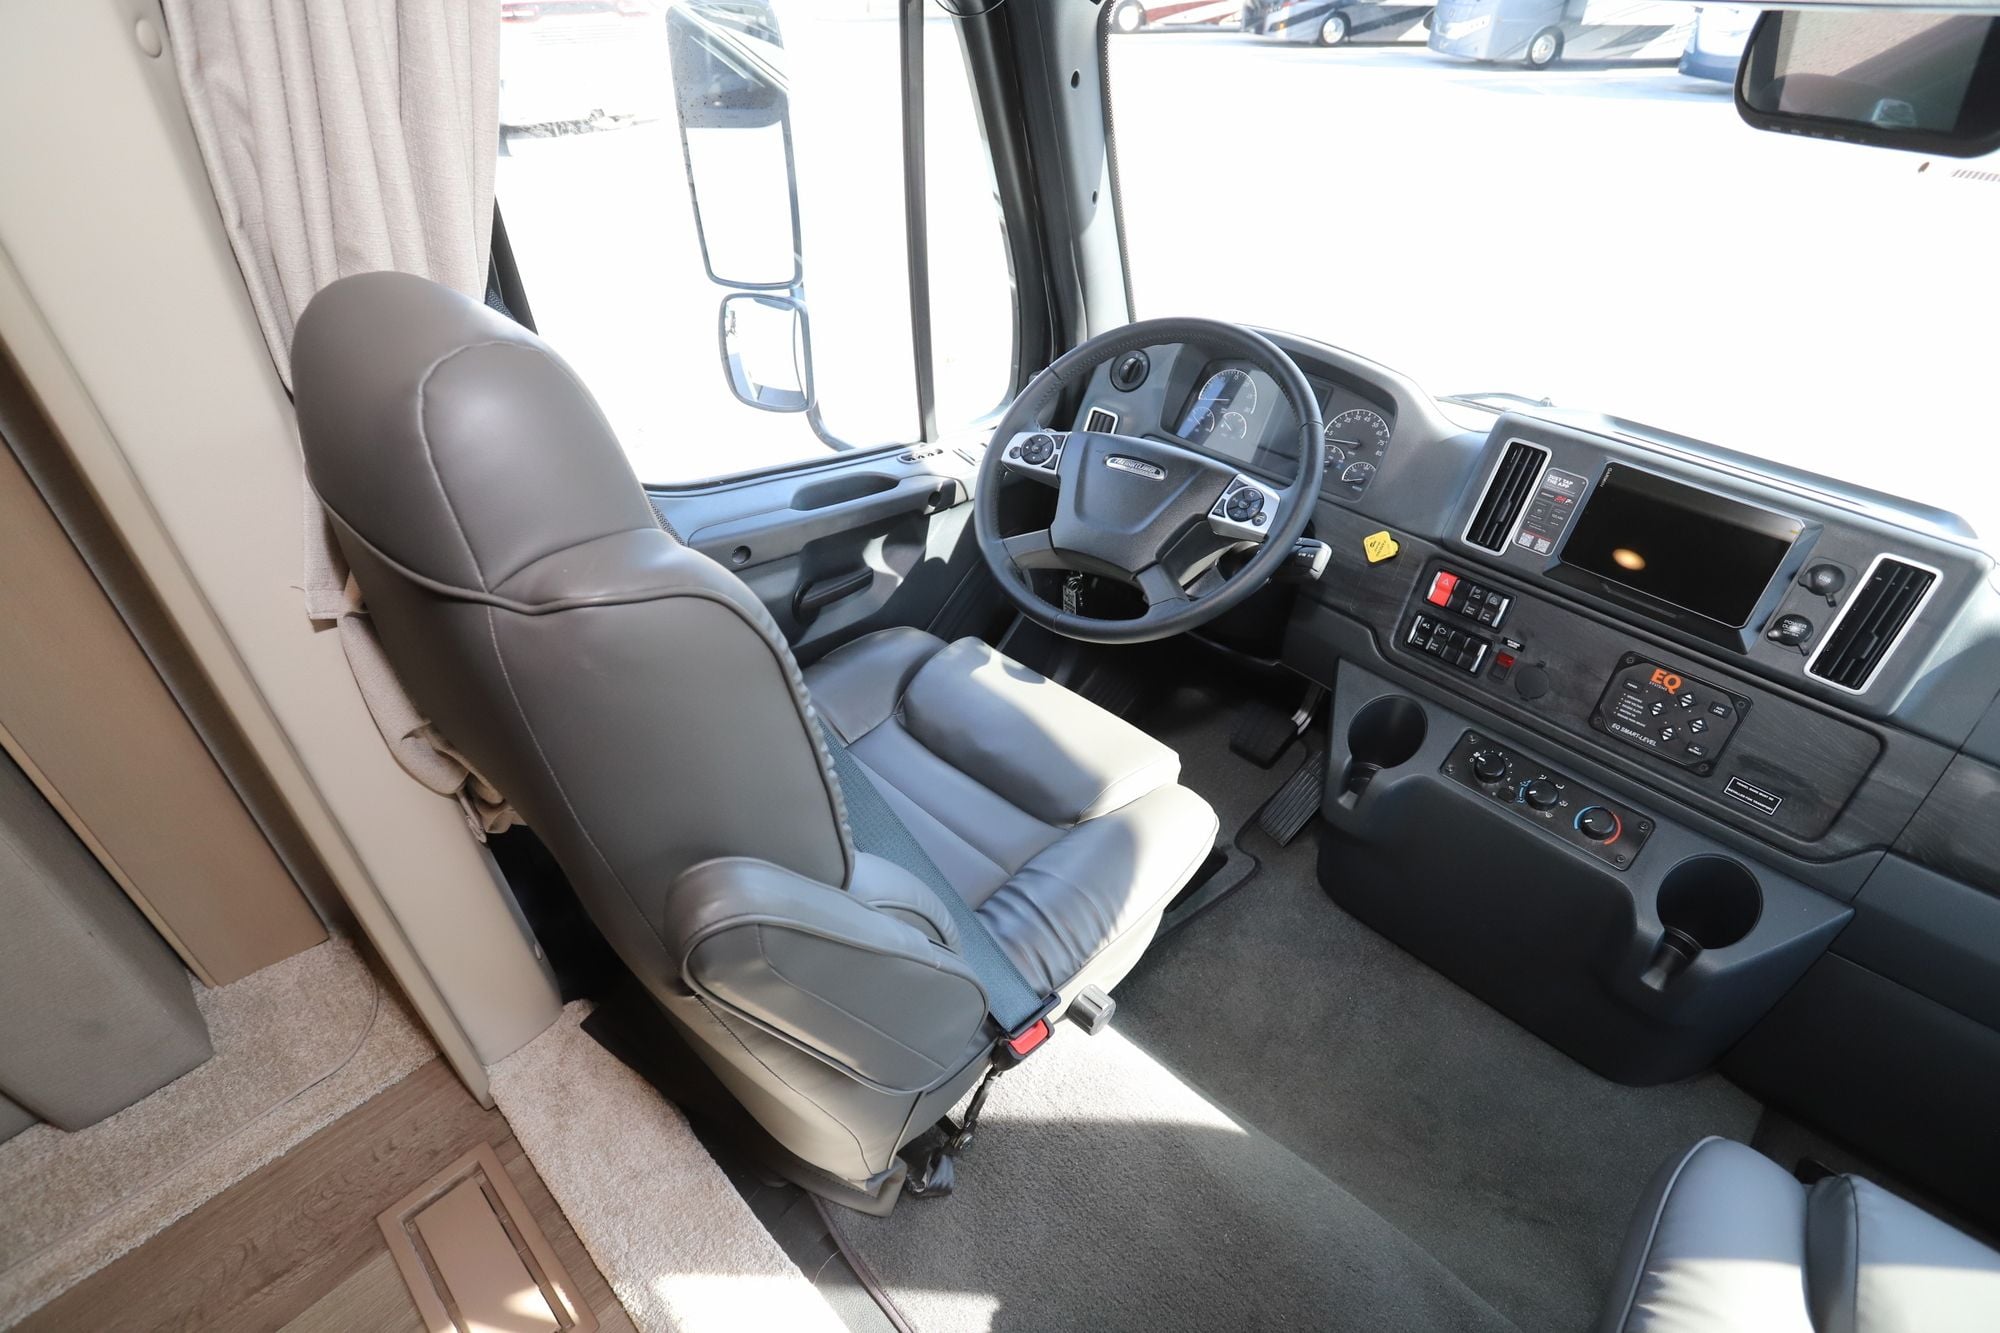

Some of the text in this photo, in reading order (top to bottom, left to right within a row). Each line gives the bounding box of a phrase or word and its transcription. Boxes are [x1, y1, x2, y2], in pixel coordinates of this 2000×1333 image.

[1548, 474, 1573, 486] JUST TAP
[1783, 619, 1808, 629] POWER
[1650, 668, 1683, 694] EQ
[1610, 722, 1657, 747] EQ SMART-LEVEL
